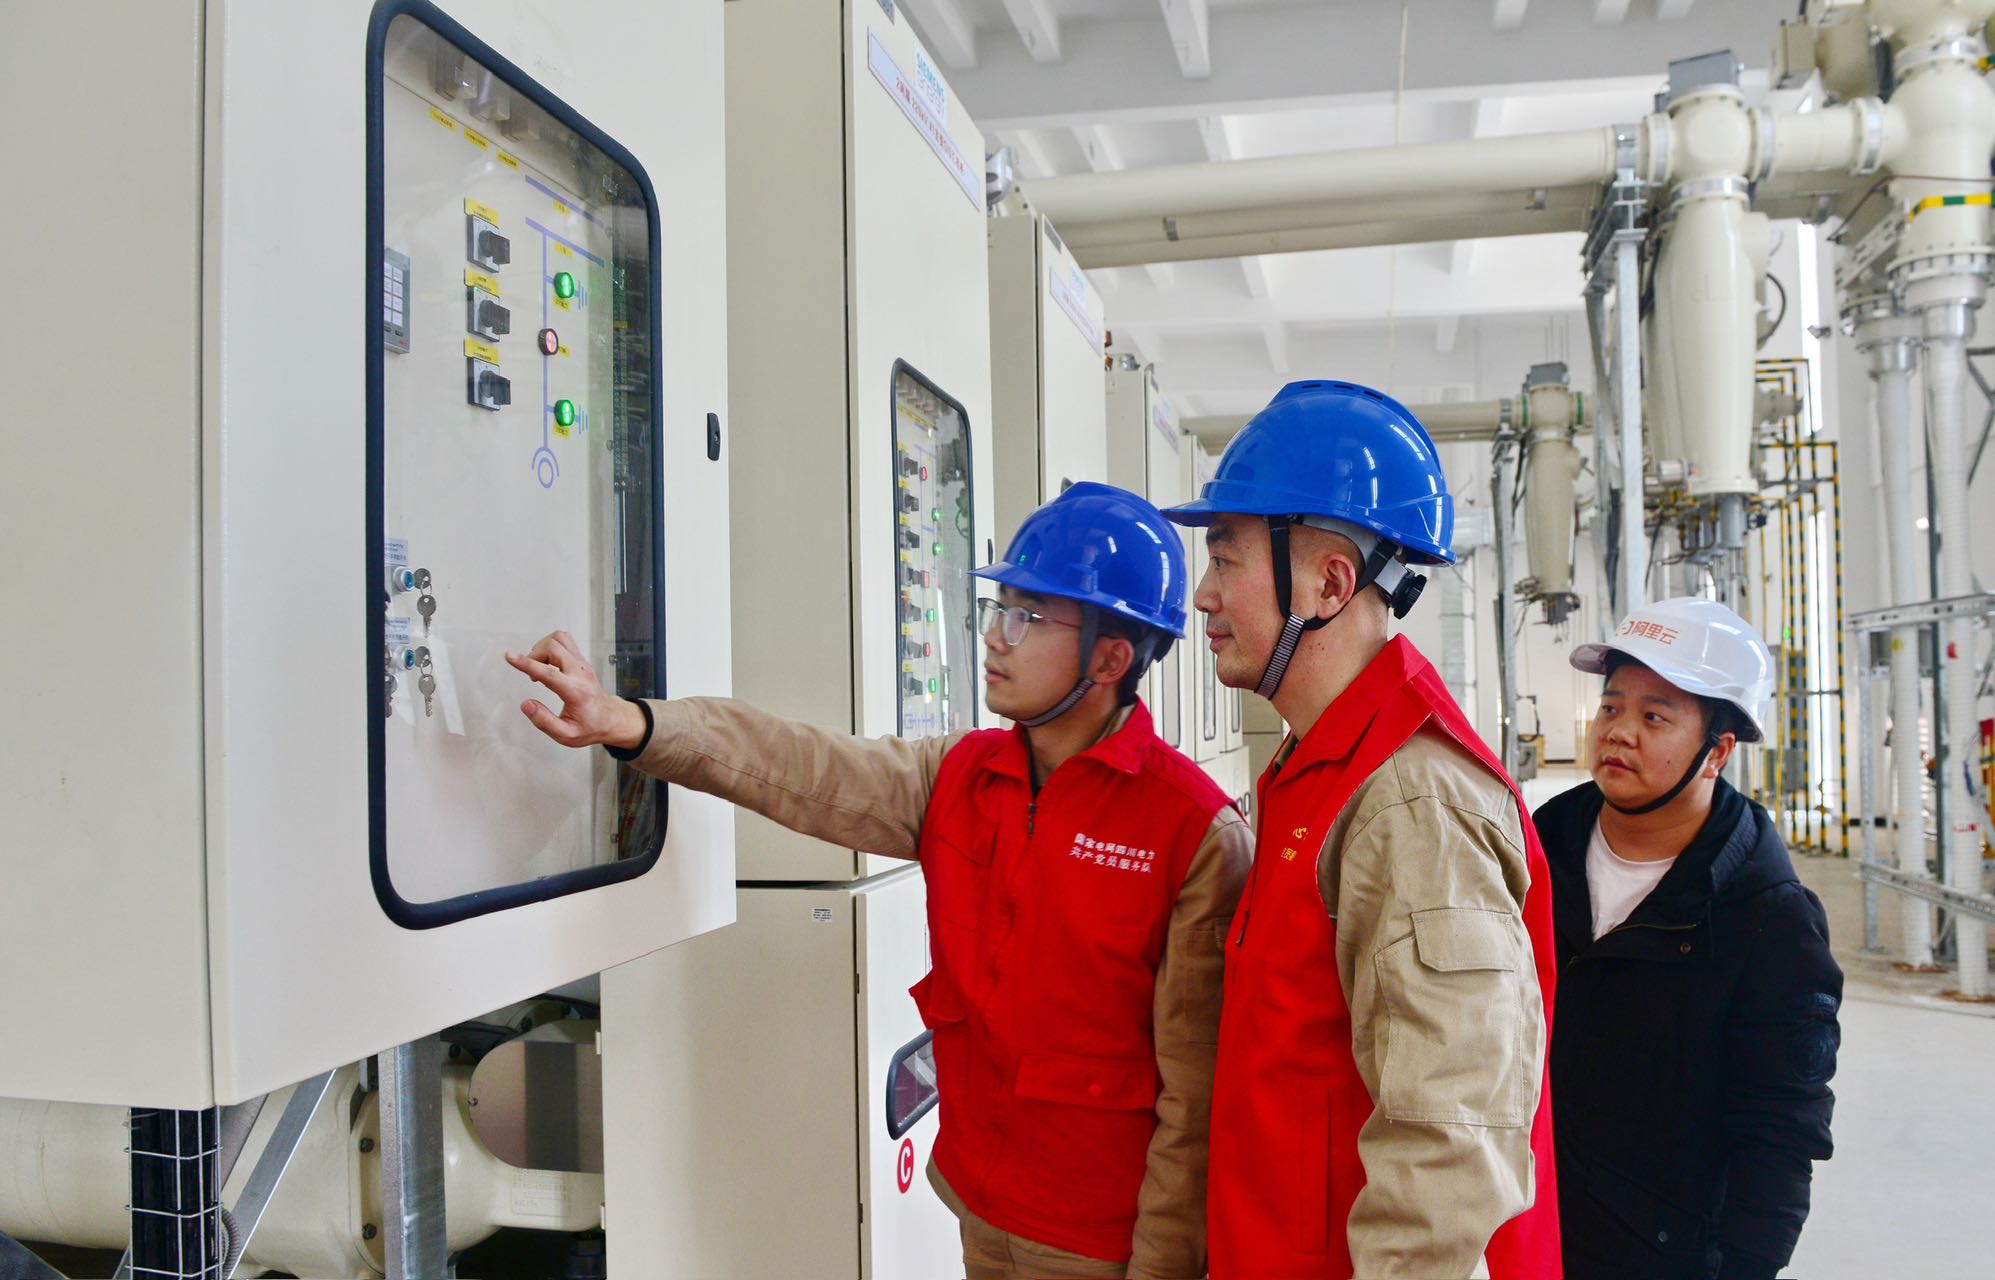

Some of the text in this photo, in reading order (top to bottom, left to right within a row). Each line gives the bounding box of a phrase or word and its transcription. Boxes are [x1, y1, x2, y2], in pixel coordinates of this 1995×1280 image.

[916, 51, 945, 103] SIEMENS
[1630, 620, 1680, 645] 阿里云
[1068, 845, 1152, 873] 共产党员服务队
[900, 1145, 911, 1184] C
